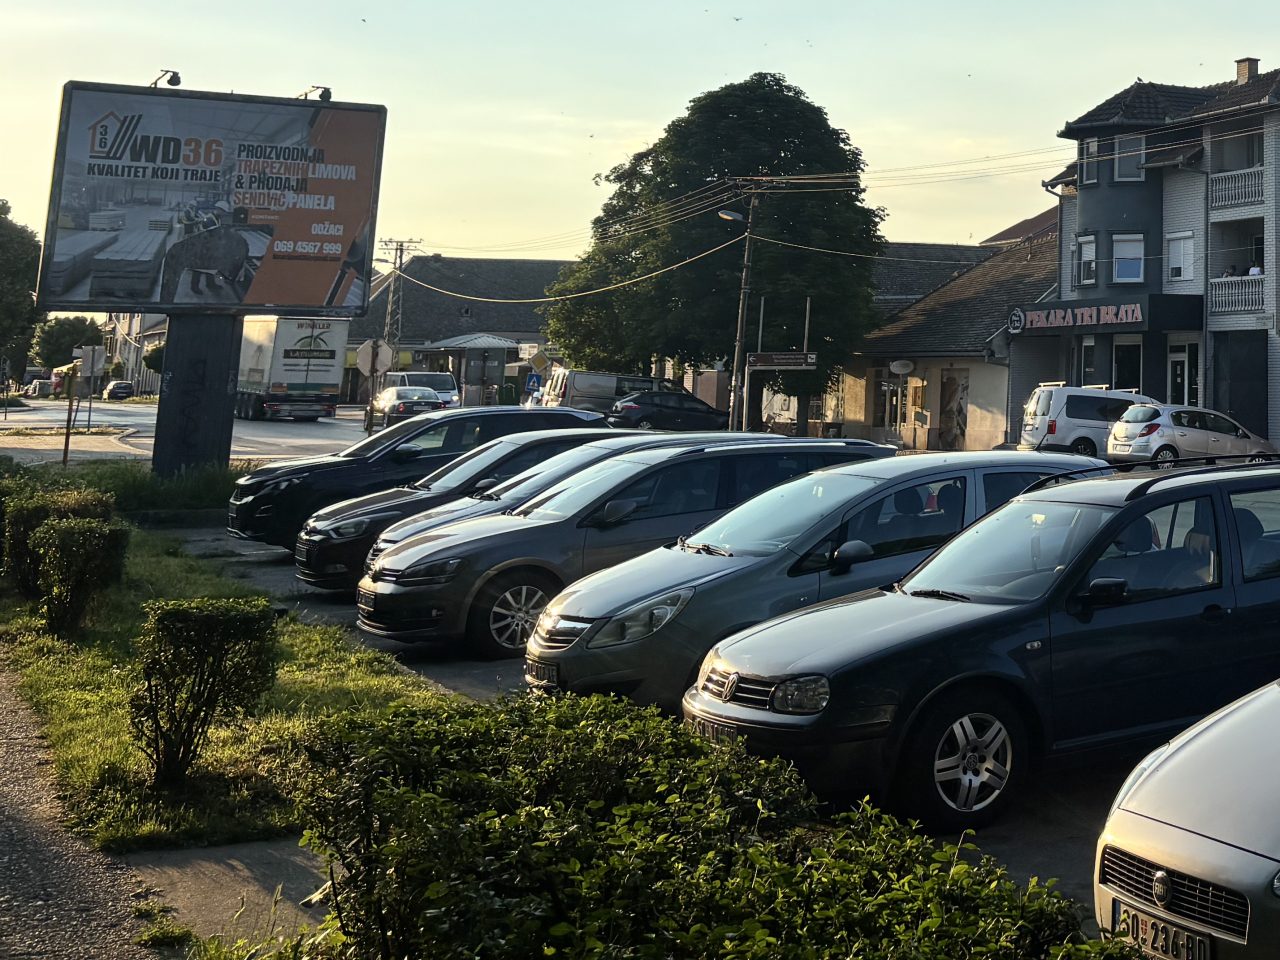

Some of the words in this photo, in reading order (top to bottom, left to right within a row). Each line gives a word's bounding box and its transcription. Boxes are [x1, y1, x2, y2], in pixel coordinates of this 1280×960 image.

[129, 134, 224, 167] WD36
[237, 143, 325, 164] PROIZVODNJA
[87, 162, 148, 179] KVALITET
[151, 166, 179, 181] KOJI
[182, 168, 221, 182] TRAJE
[237, 159, 308, 178] TRAPEZNIH
[308, 163, 357, 180] LIMOVA
[235, 174, 244, 189] &
[248, 175, 308, 192] PRODAJA
[288, 193, 335, 210] PANELA
[273, 240, 294, 252] 069
[1025, 308, 1074, 328] PEKARA
[1074, 306, 1098, 325] TRI
[1099, 303, 1143, 324] BRATA
[1155, 883, 1168, 897] FIAT
